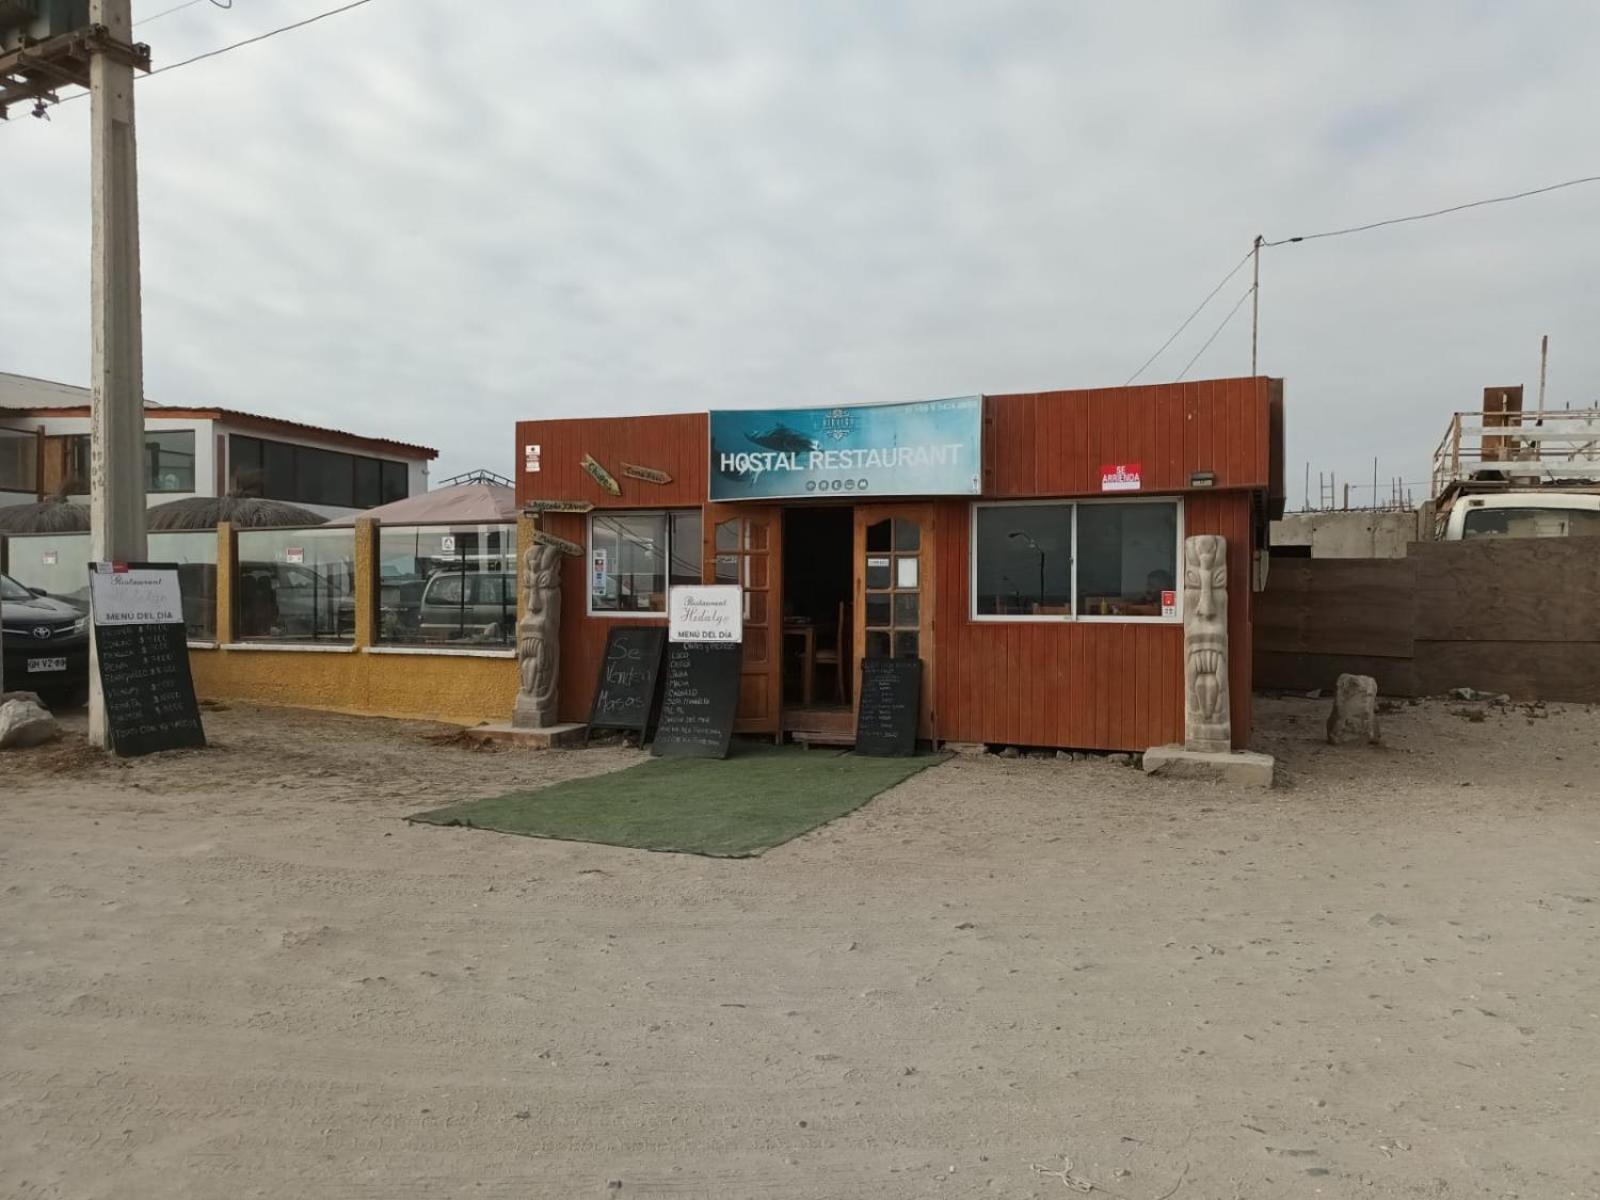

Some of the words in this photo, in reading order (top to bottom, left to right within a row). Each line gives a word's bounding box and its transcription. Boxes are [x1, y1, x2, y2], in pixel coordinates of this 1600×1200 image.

[720, 452, 804, 473] HOSTAL
[809, 444, 963, 470] RESTAURANT
[1116, 465, 1126, 474] SE
[1102, 473, 1140, 482] ARRIENDA
[106, 610, 134, 621] MENÚ
[136, 612, 154, 620] DEL
[678, 629, 701, 639] MENÚ
[719, 629, 732, 638] DÍA
